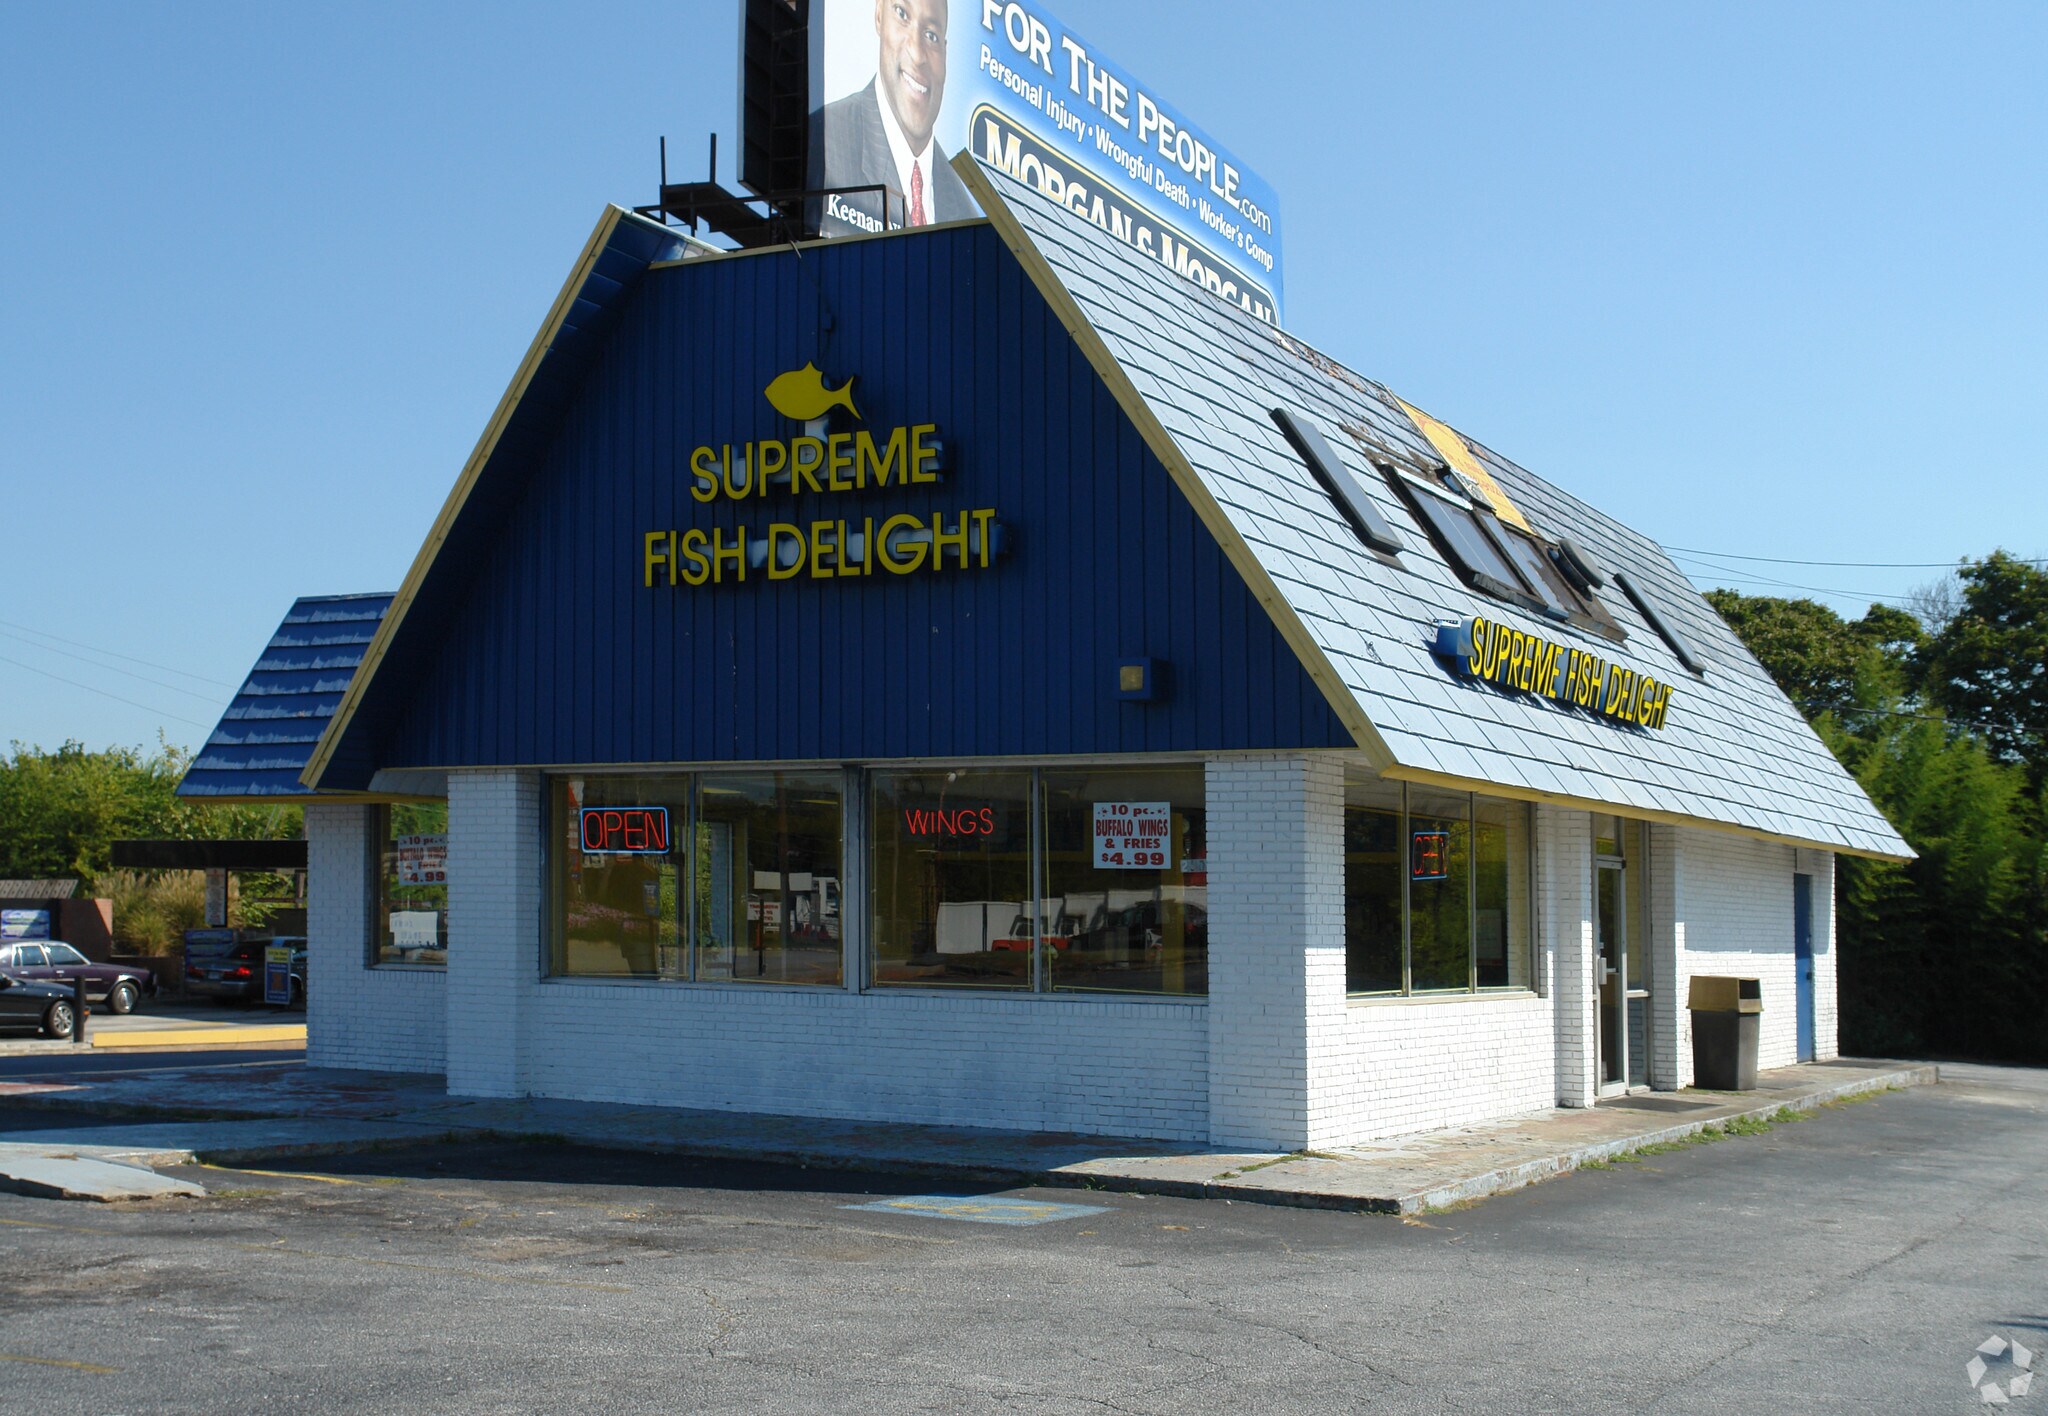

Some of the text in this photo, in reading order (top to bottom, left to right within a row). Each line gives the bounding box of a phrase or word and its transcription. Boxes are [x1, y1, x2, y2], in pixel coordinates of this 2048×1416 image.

[981, 0, 1271, 235] FOR THE PEOPLE.com
[979, 44, 1274, 273] Personal Injury Wrongful Death Worker's Comp
[826, 193, 884, 233] Keenan
[690, 423, 937, 503] SUPREME
[644, 508, 996, 587] FISH DELIGHT
[1469, 616, 1674, 731] SUPREME FISH DELIGHT
[905, 807, 994, 835] WINGS
[1095, 819, 1169, 837] BUFFALO WINGS
[1111, 804, 1128, 815] 10
[583, 811, 665, 849] OPEN
[1104, 838, 1160, 849] & FRIES
[1101, 852, 1165, 866] $4.99
